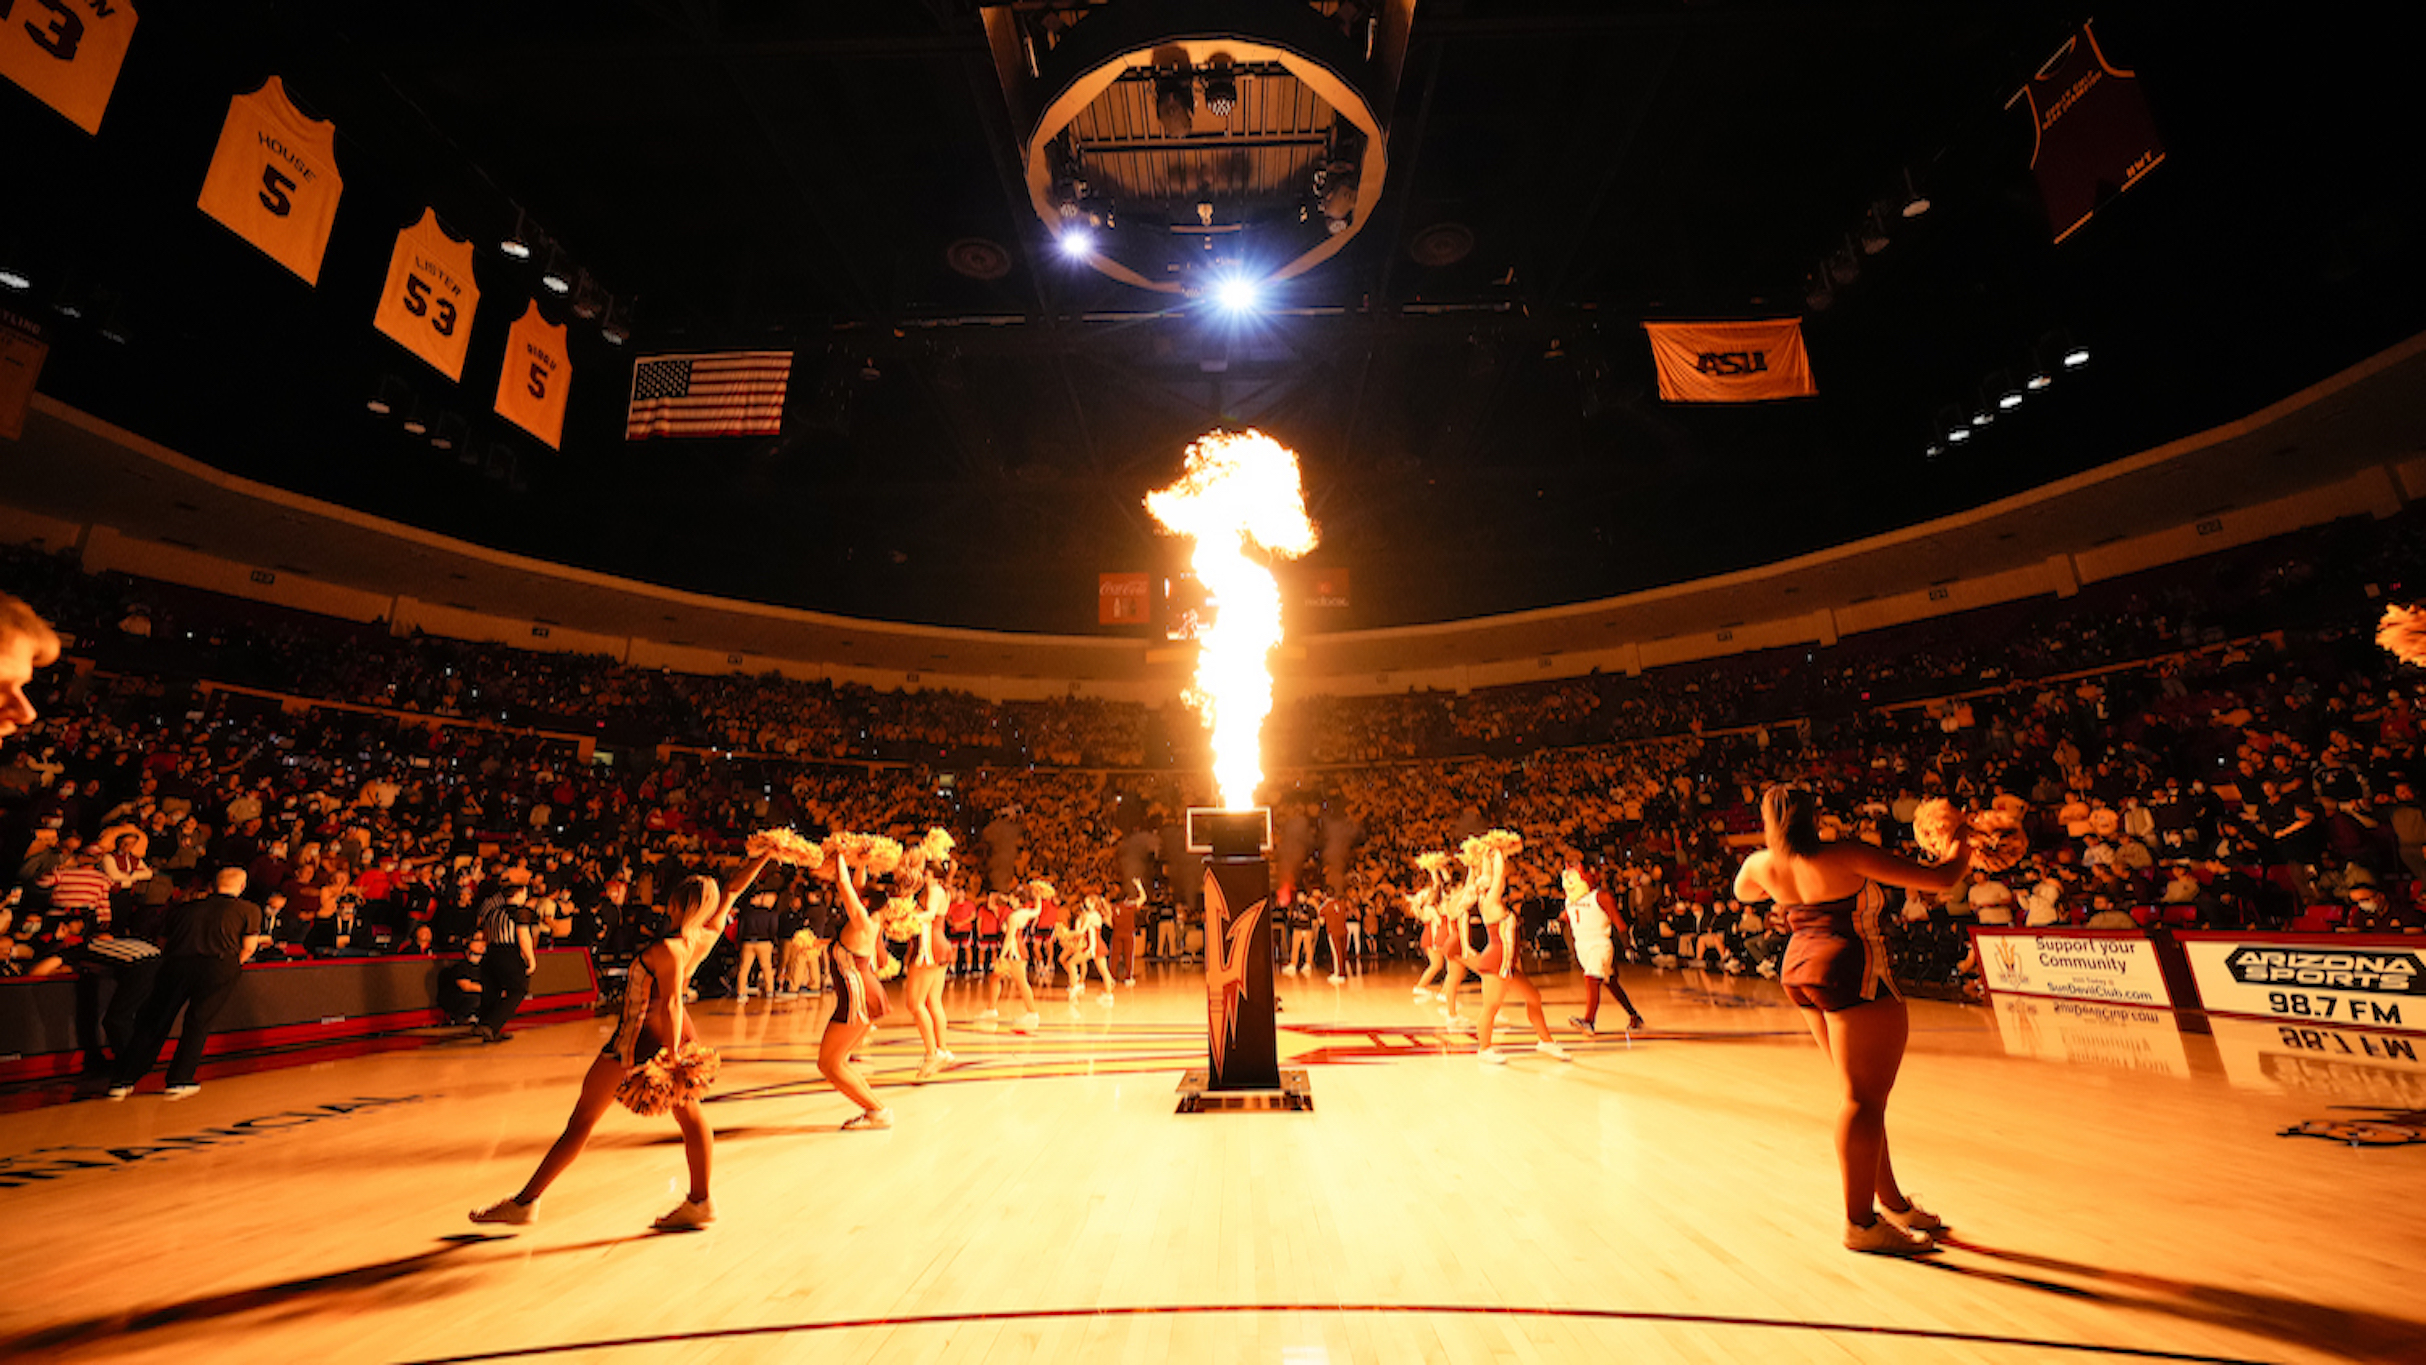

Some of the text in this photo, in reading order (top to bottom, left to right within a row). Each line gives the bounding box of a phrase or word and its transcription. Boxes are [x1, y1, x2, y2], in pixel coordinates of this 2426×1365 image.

[258, 131, 316, 183] HOUSE
[259, 163, 297, 217] 5
[415, 255, 461, 297] LISTER
[403, 272, 457, 336] 53
[1696, 351, 1768, 376] ASU
[527, 361, 548, 399] 5
[2036, 937, 2135, 955] Support your
[2039, 952, 2126, 974] Community
[2236, 951, 2417, 976] ARIZONA
[2244, 964, 2410, 990] SPORTS
[2047, 981, 2153, 1002] SunDevilClub.com
[2269, 991, 2402, 1025] 98.7 FM
